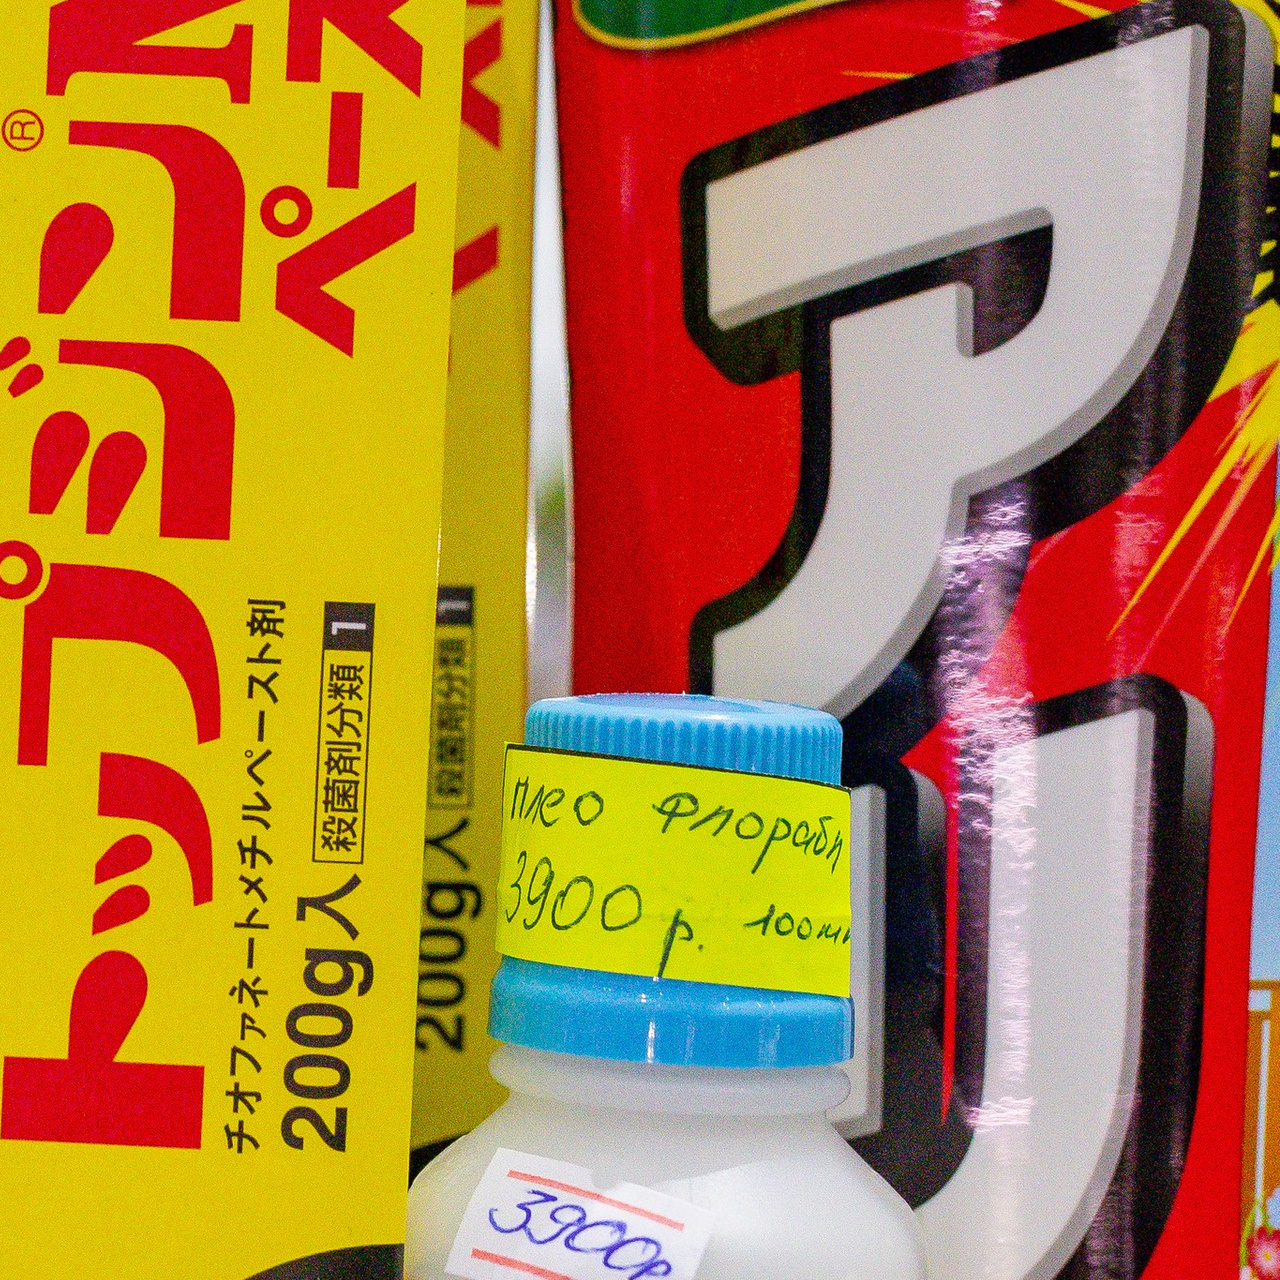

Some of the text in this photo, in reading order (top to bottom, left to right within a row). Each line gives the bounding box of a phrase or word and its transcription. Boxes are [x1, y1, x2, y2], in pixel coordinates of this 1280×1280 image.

[224, 597, 287, 1154] チオファネートメチルペースト剤
[280, 873, 376, 1154] 200g入
[504, 850, 643, 933] 3900
